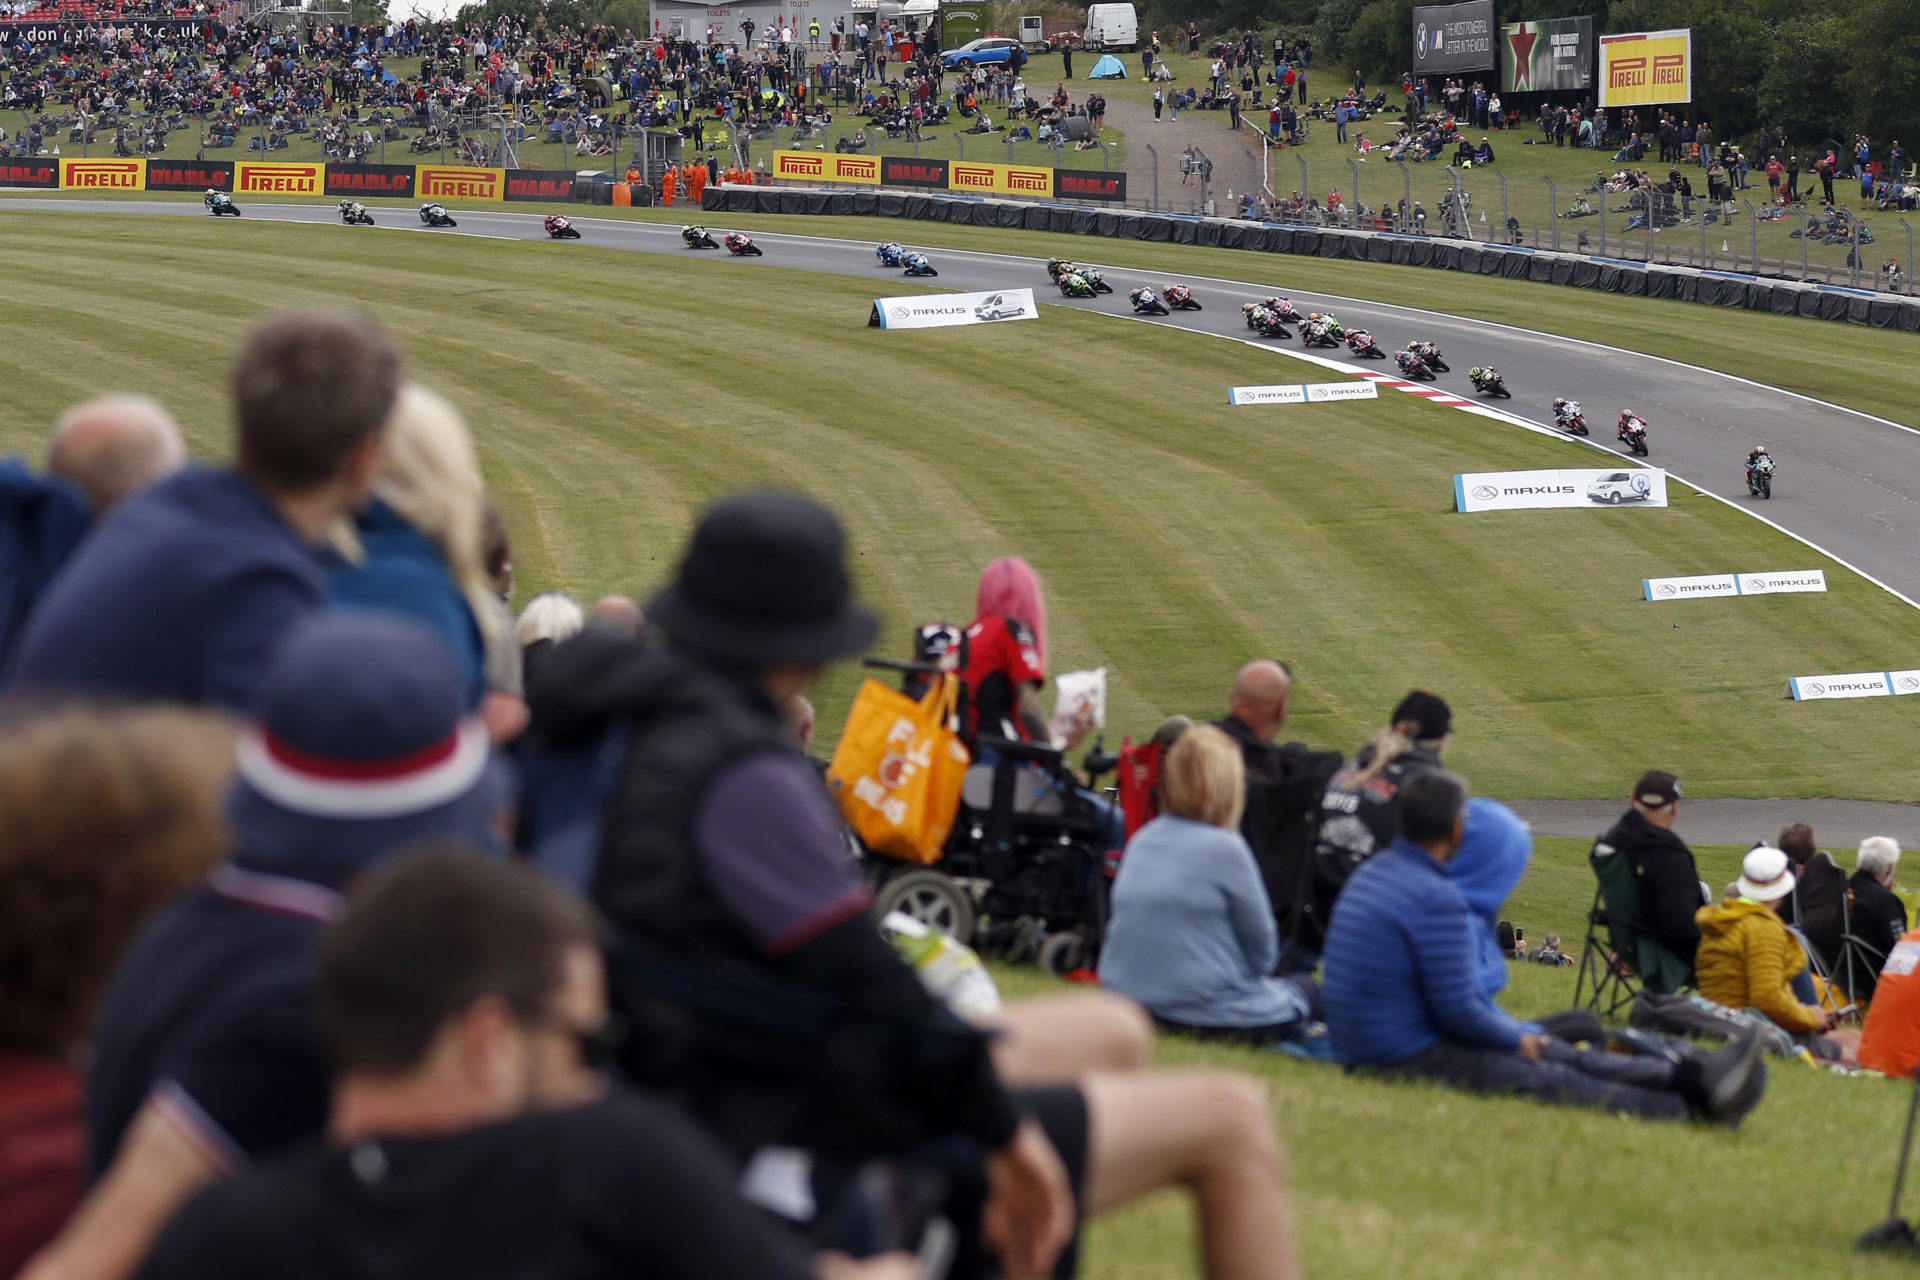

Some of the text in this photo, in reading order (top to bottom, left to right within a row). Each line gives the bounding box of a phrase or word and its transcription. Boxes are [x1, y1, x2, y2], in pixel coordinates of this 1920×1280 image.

[707, 9, 731, 17] TOILETS
[1610, 54, 1683, 88] PIRELLI PIRELLI
[780, 156, 875, 178] PIRELLI PIRELLI
[66, 163, 138, 187] PIRELLI
[241, 167, 316, 191] PIRELLI
[955, 167, 1047, 191] PIRELLI PIRELLI
[421, 170, 496, 198] PIRELLI
[913, 307, 966, 316] MAXUS
[1258, 391, 1301, 399] MAXUS
[1331, 387, 1373, 396] MAXUS
[1503, 485, 1575, 496] MAXUS
[1680, 582, 1732, 592] MAXUS
[1769, 578, 1821, 587] MAXUS
[1829, 682, 1884, 692] MAXUS
